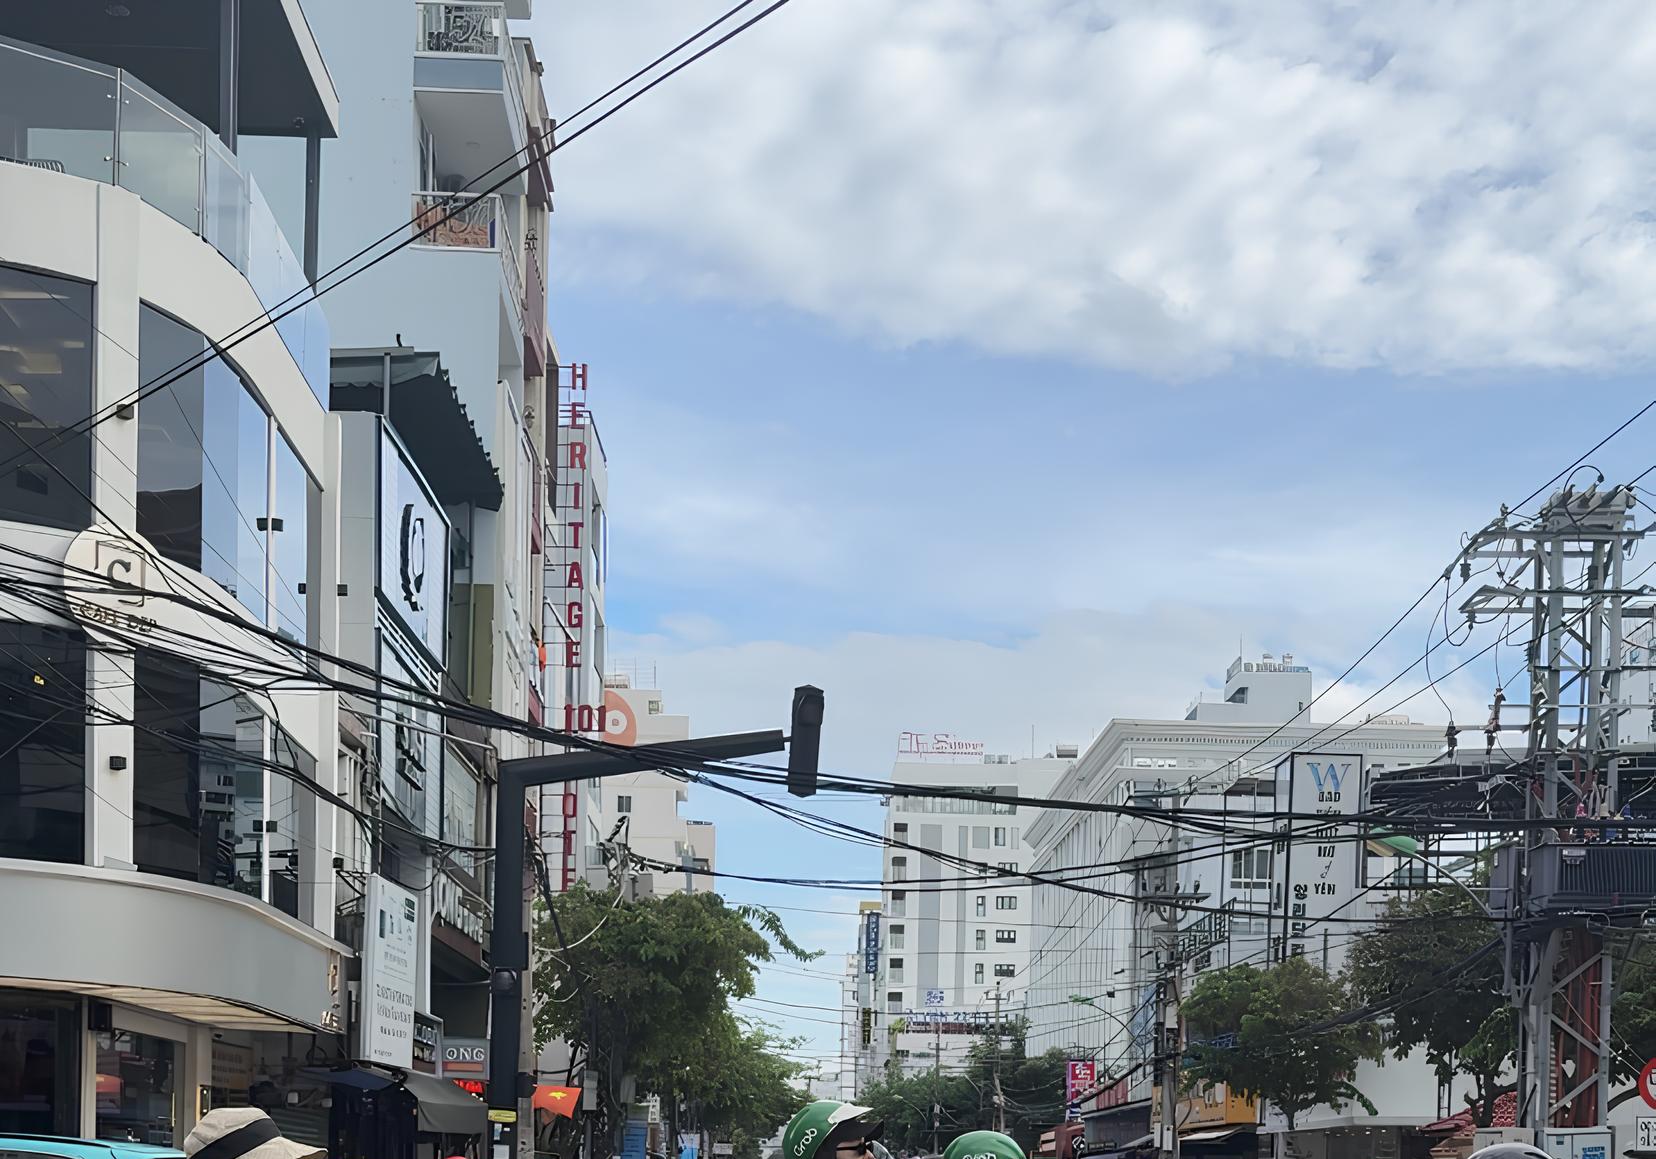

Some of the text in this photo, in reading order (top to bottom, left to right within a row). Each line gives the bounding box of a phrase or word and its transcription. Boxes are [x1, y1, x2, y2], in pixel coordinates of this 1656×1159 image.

[566, 363, 588, 668] HERITAGE
[565, 704, 607, 733] 101
[1307, 762, 1352, 791] W
[793, 1128, 818, 1157] Grab
